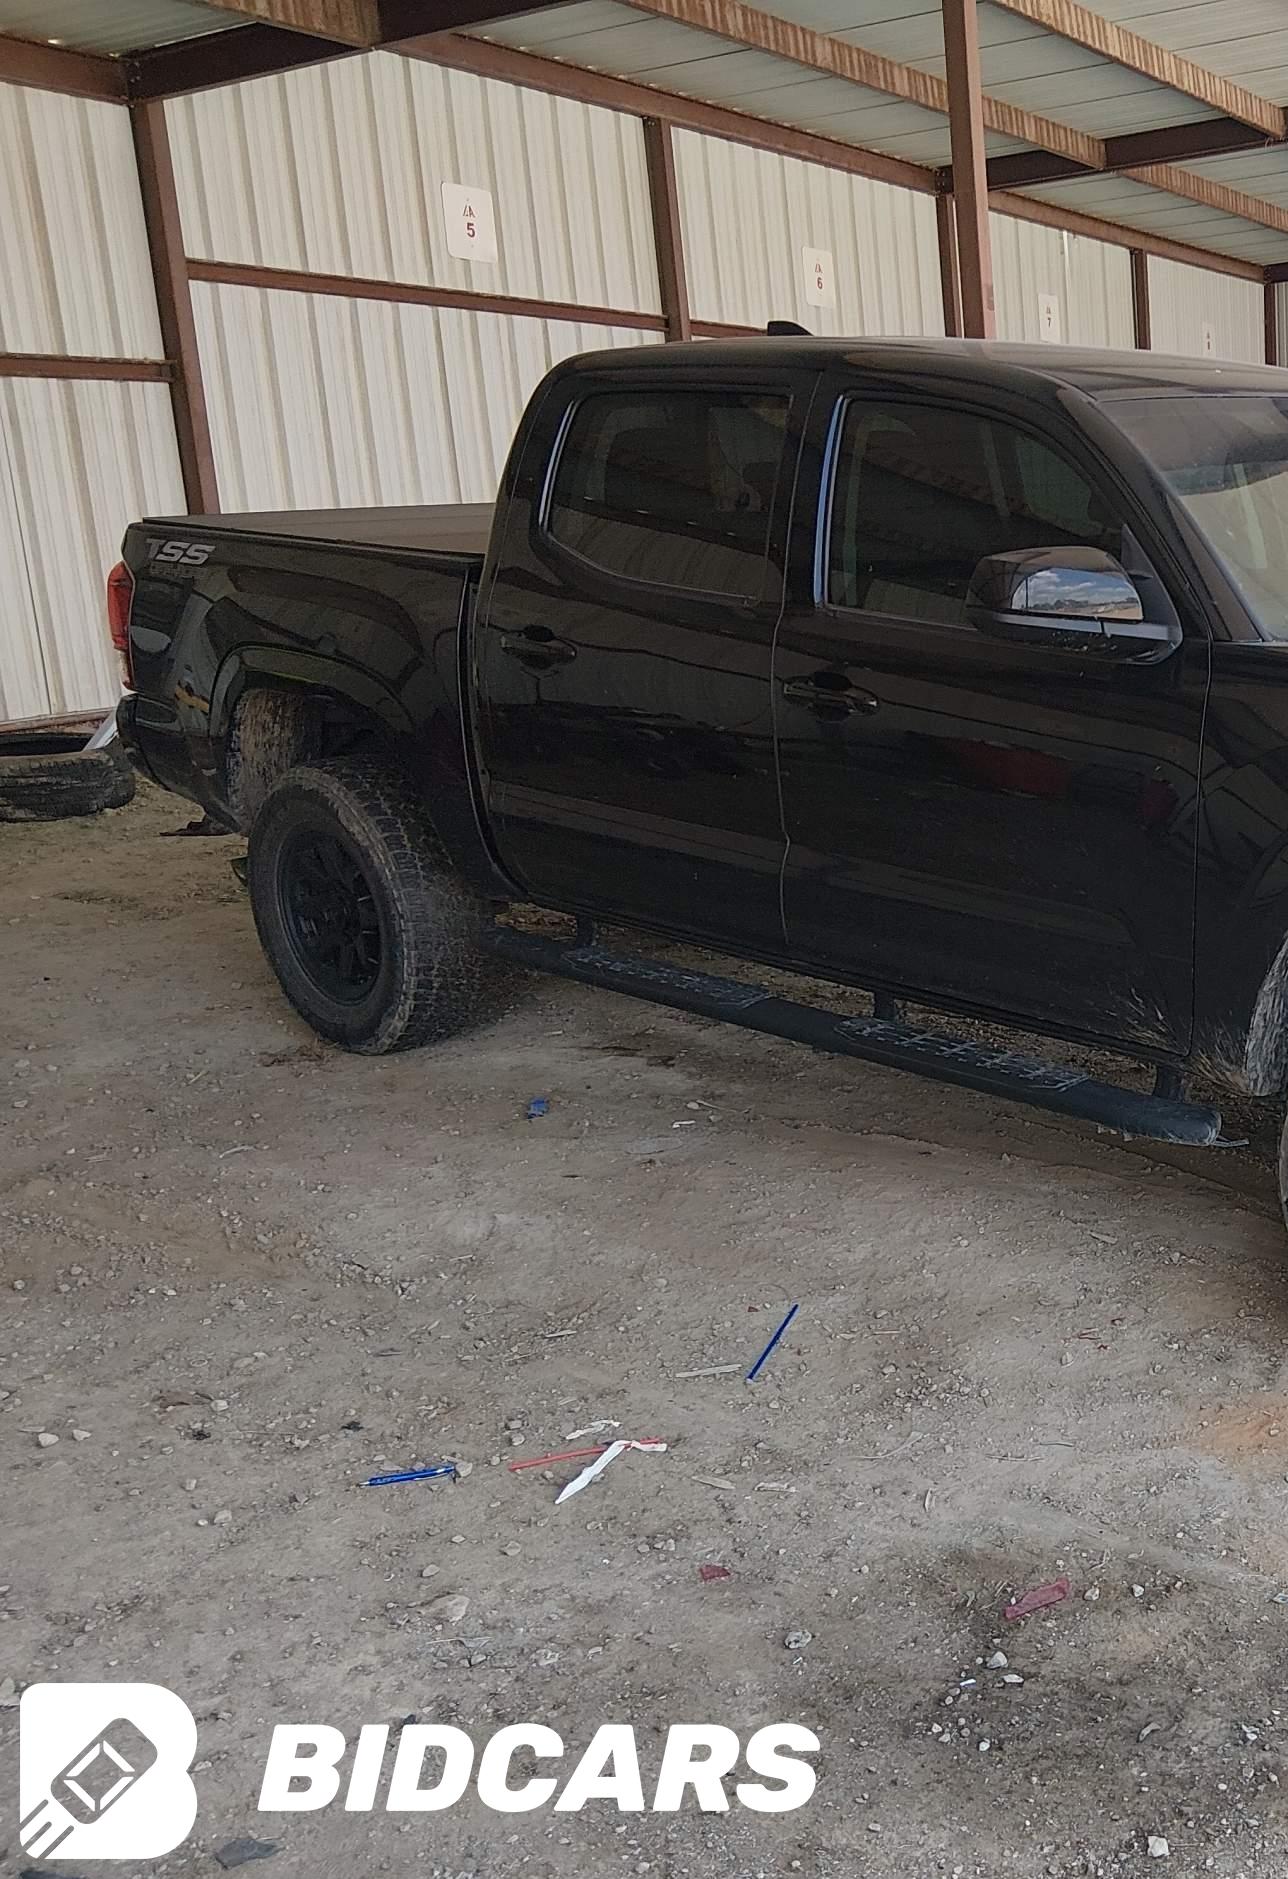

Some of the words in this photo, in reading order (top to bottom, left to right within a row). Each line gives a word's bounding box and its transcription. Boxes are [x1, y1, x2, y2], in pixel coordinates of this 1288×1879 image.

[466, 222, 476, 238] 5
[817, 277, 823, 290] 6
[146, 538, 216, 565] TSS
